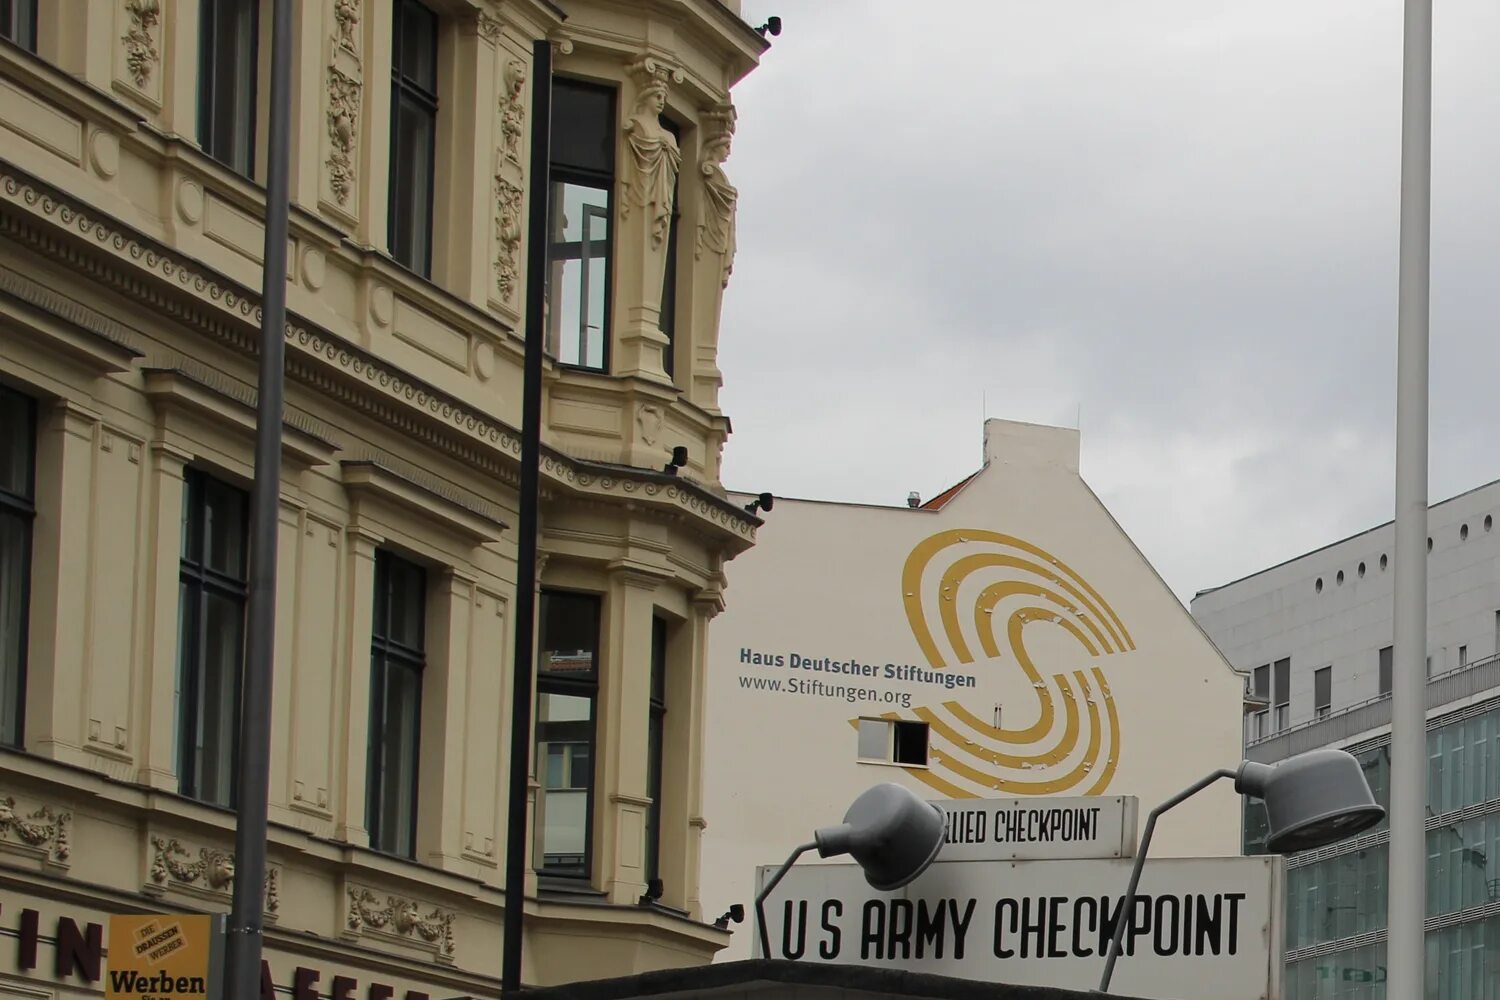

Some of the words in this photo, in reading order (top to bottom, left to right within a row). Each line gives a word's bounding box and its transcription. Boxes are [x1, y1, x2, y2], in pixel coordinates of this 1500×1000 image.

[740, 648, 784, 667] Haus
[790, 653, 879, 677] Deutscher
[884, 663, 976, 689] Stiftungen
[739, 676, 911, 708] www.Stiftungen.org
[945, 811, 987, 844] LLIED
[994, 808, 1100, 843] CHECKPOINT
[0, 903, 103, 981] IN
[136, 926, 178, 953] DRAUSSEN
[782, 899, 808, 960] U
[819, 899, 843, 960] S
[860, 898, 977, 960] ARMY
[994, 892, 1246, 959] CHECKPOINT
[150, 938, 184, 960] WERBER
[110, 970, 205, 993] Werben
